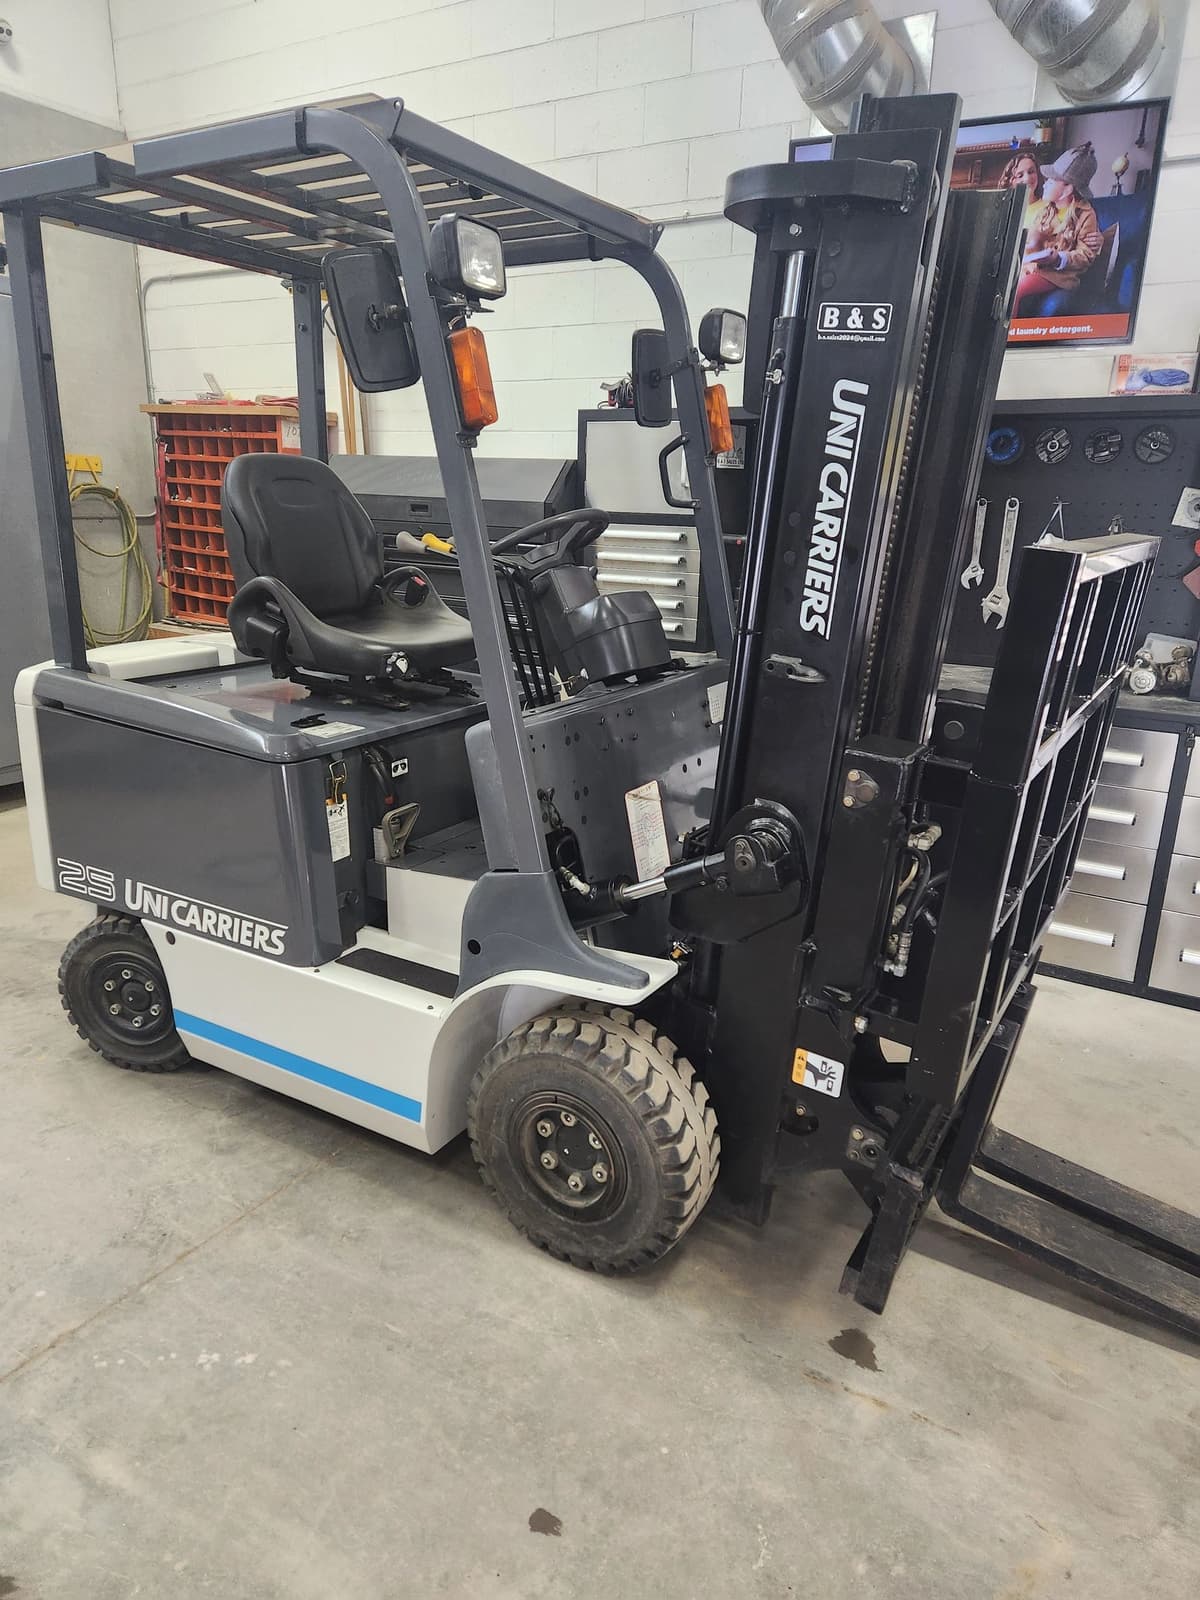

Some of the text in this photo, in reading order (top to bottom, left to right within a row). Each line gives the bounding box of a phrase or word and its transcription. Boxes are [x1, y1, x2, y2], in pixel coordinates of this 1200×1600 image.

[823, 307, 887, 329] B & S
[1016, 326, 1048, 336] laundry
[1049, 325, 1094, 335] detergent.
[57, 857, 116, 902] 25
